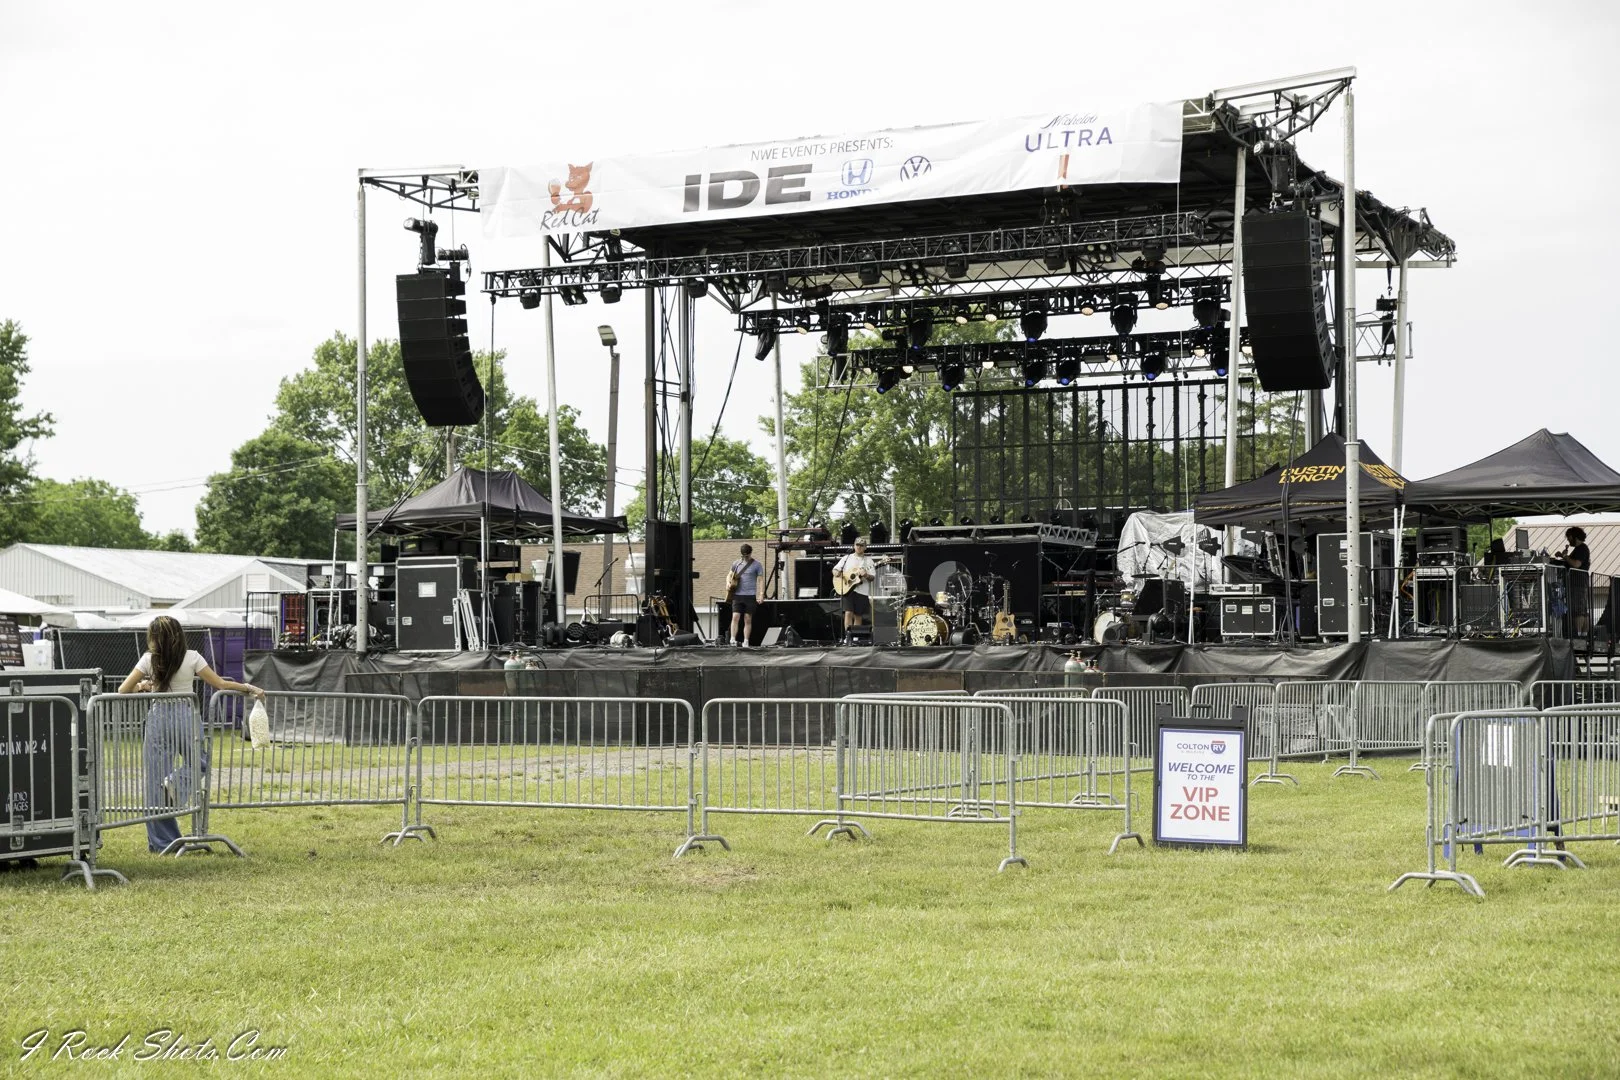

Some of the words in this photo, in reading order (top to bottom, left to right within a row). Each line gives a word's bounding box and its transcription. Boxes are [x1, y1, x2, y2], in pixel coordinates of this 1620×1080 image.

[1025, 127, 1113, 152] ULTRA
[751, 147, 779, 161] NWE
[781, 143, 827, 158] EVENTS
[829, 137, 893, 154] PRESENTS:
[682, 163, 813, 213] IDE
[827, 188, 876, 201] HON
[1279, 473, 1339, 484] LYNCH
[1281, 465, 1346, 477] DUSTIN
[1168, 762, 1235, 774] WELCOME
[1182, 786, 1219, 802] VIP
[1170, 803, 1230, 821] ZONE
